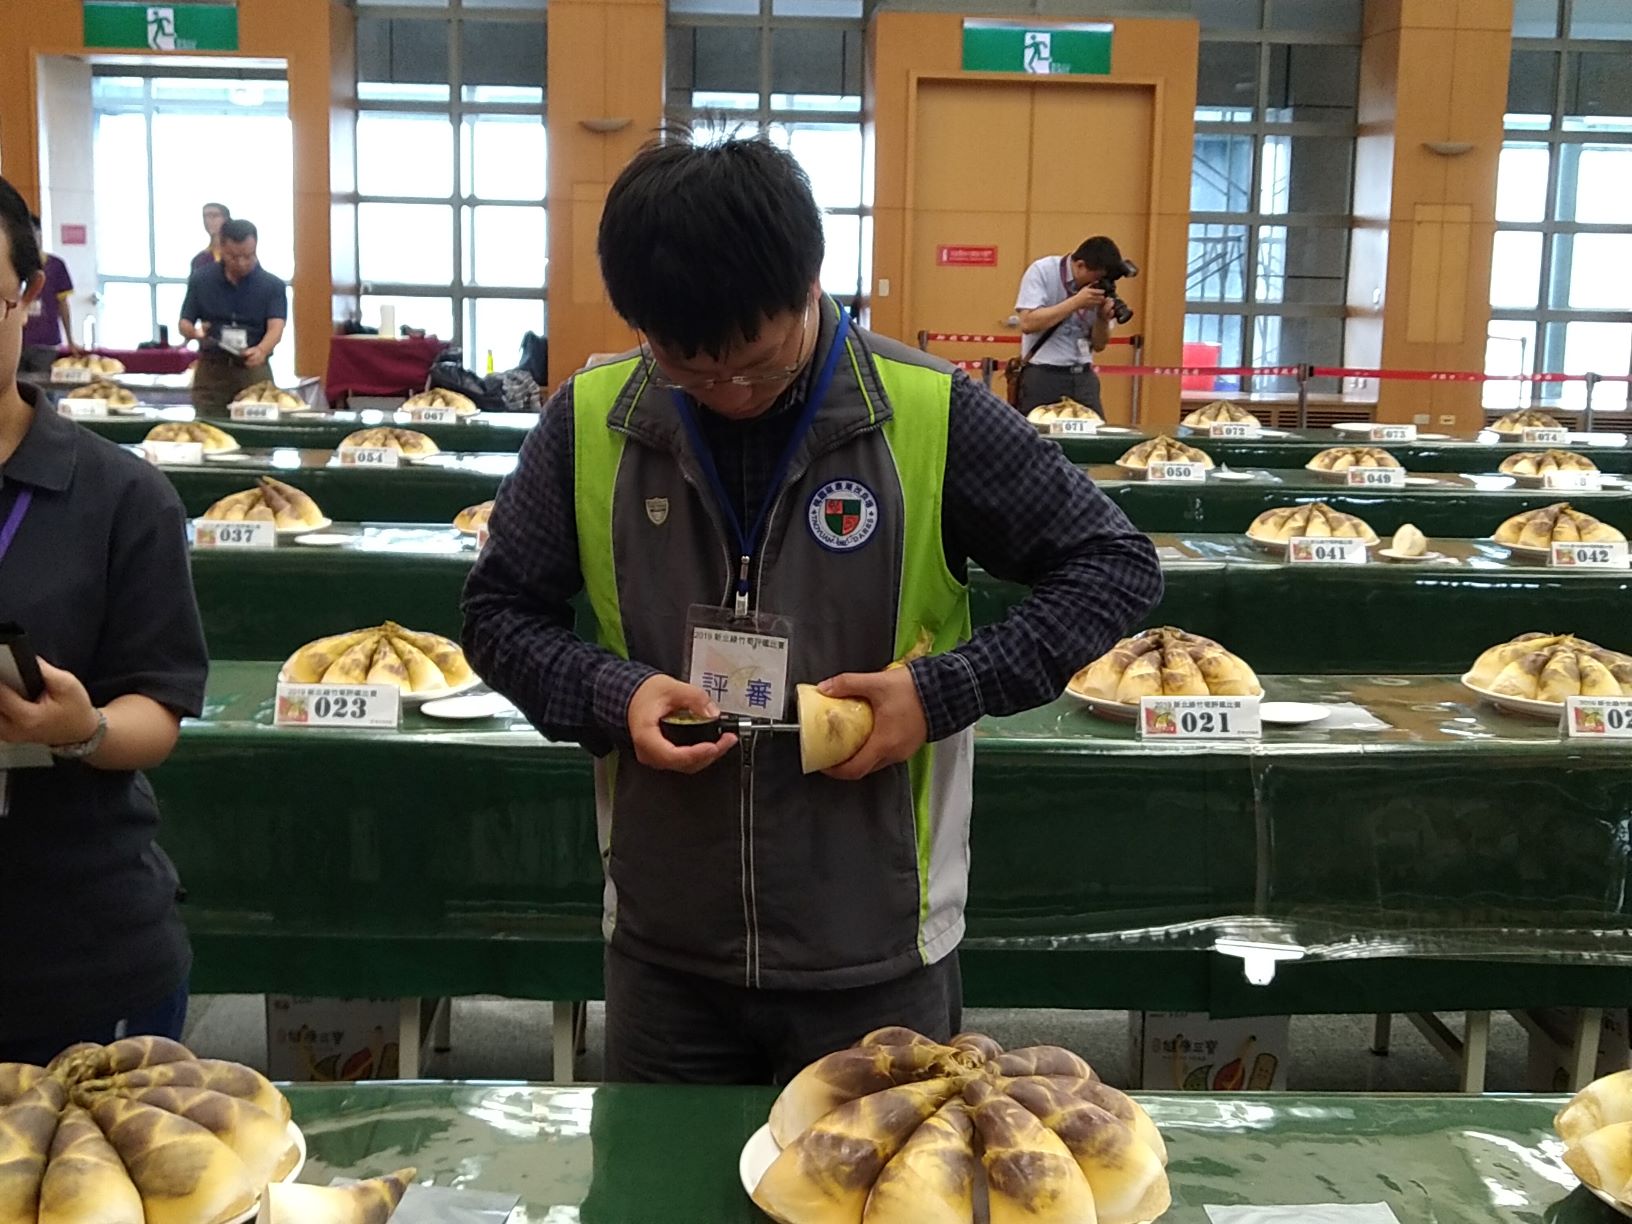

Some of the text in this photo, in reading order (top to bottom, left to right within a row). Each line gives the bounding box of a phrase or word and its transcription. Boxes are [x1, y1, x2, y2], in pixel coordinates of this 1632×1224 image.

[424, 412, 445, 421] 067
[1065, 423, 1084, 431] 071
[1225, 427, 1246, 436] 072
[1386, 430, 1407, 439] 073
[1538, 431, 1558, 442] 074
[357, 452, 383, 463] 054
[1166, 467, 1191, 477] 050
[220, 528, 254, 543] 037
[1315, 546, 1346, 560] 041
[1577, 549, 1610, 563] 042
[314, 697, 367, 719] 023
[1181, 711, 1230, 733] 021
